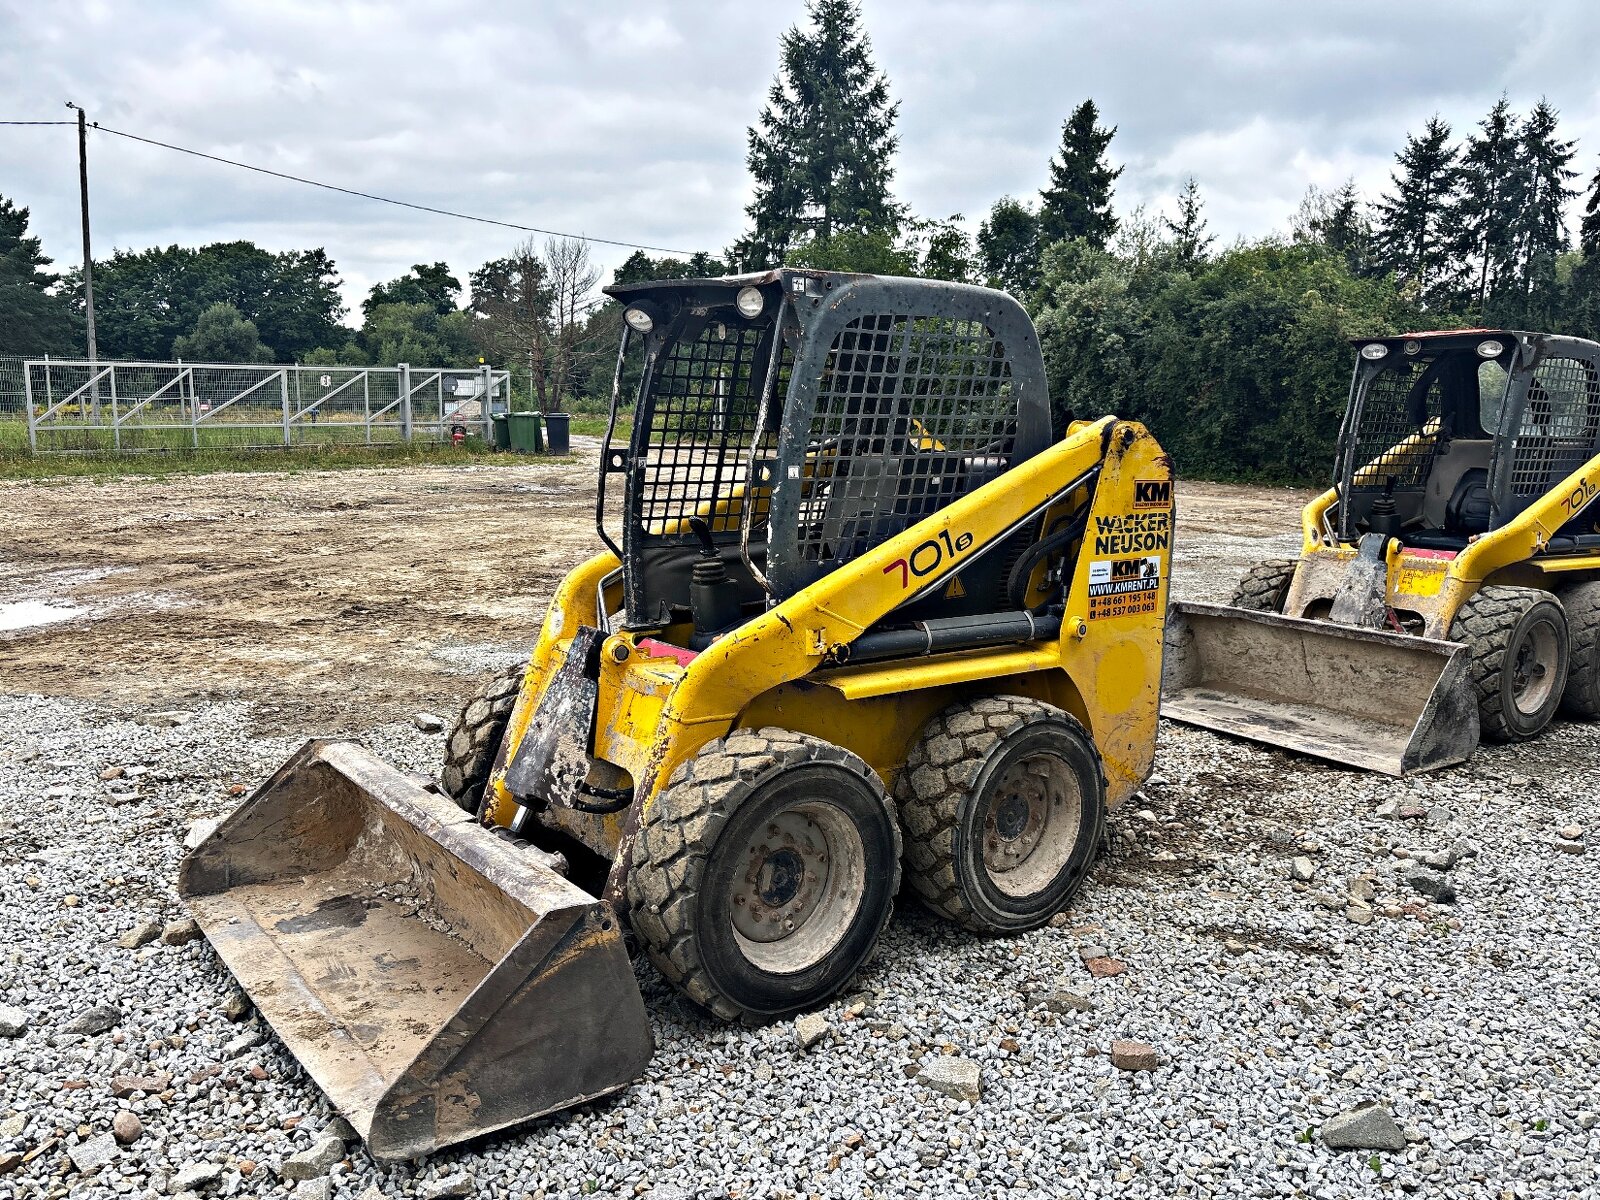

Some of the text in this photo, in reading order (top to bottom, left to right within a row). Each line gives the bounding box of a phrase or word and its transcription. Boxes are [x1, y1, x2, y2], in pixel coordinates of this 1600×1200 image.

[1135, 482, 1170, 502] KM
[1095, 512, 1169, 535] WACKER
[1095, 531, 1169, 555] NEUSON
[1111, 560, 1140, 577] KM
[1089, 578, 1159, 597] WWW.KMRENT.PL
[1097, 591, 1156, 607] +48 661 195 148
[1097, 602, 1155, 618] +48 537 003 063
